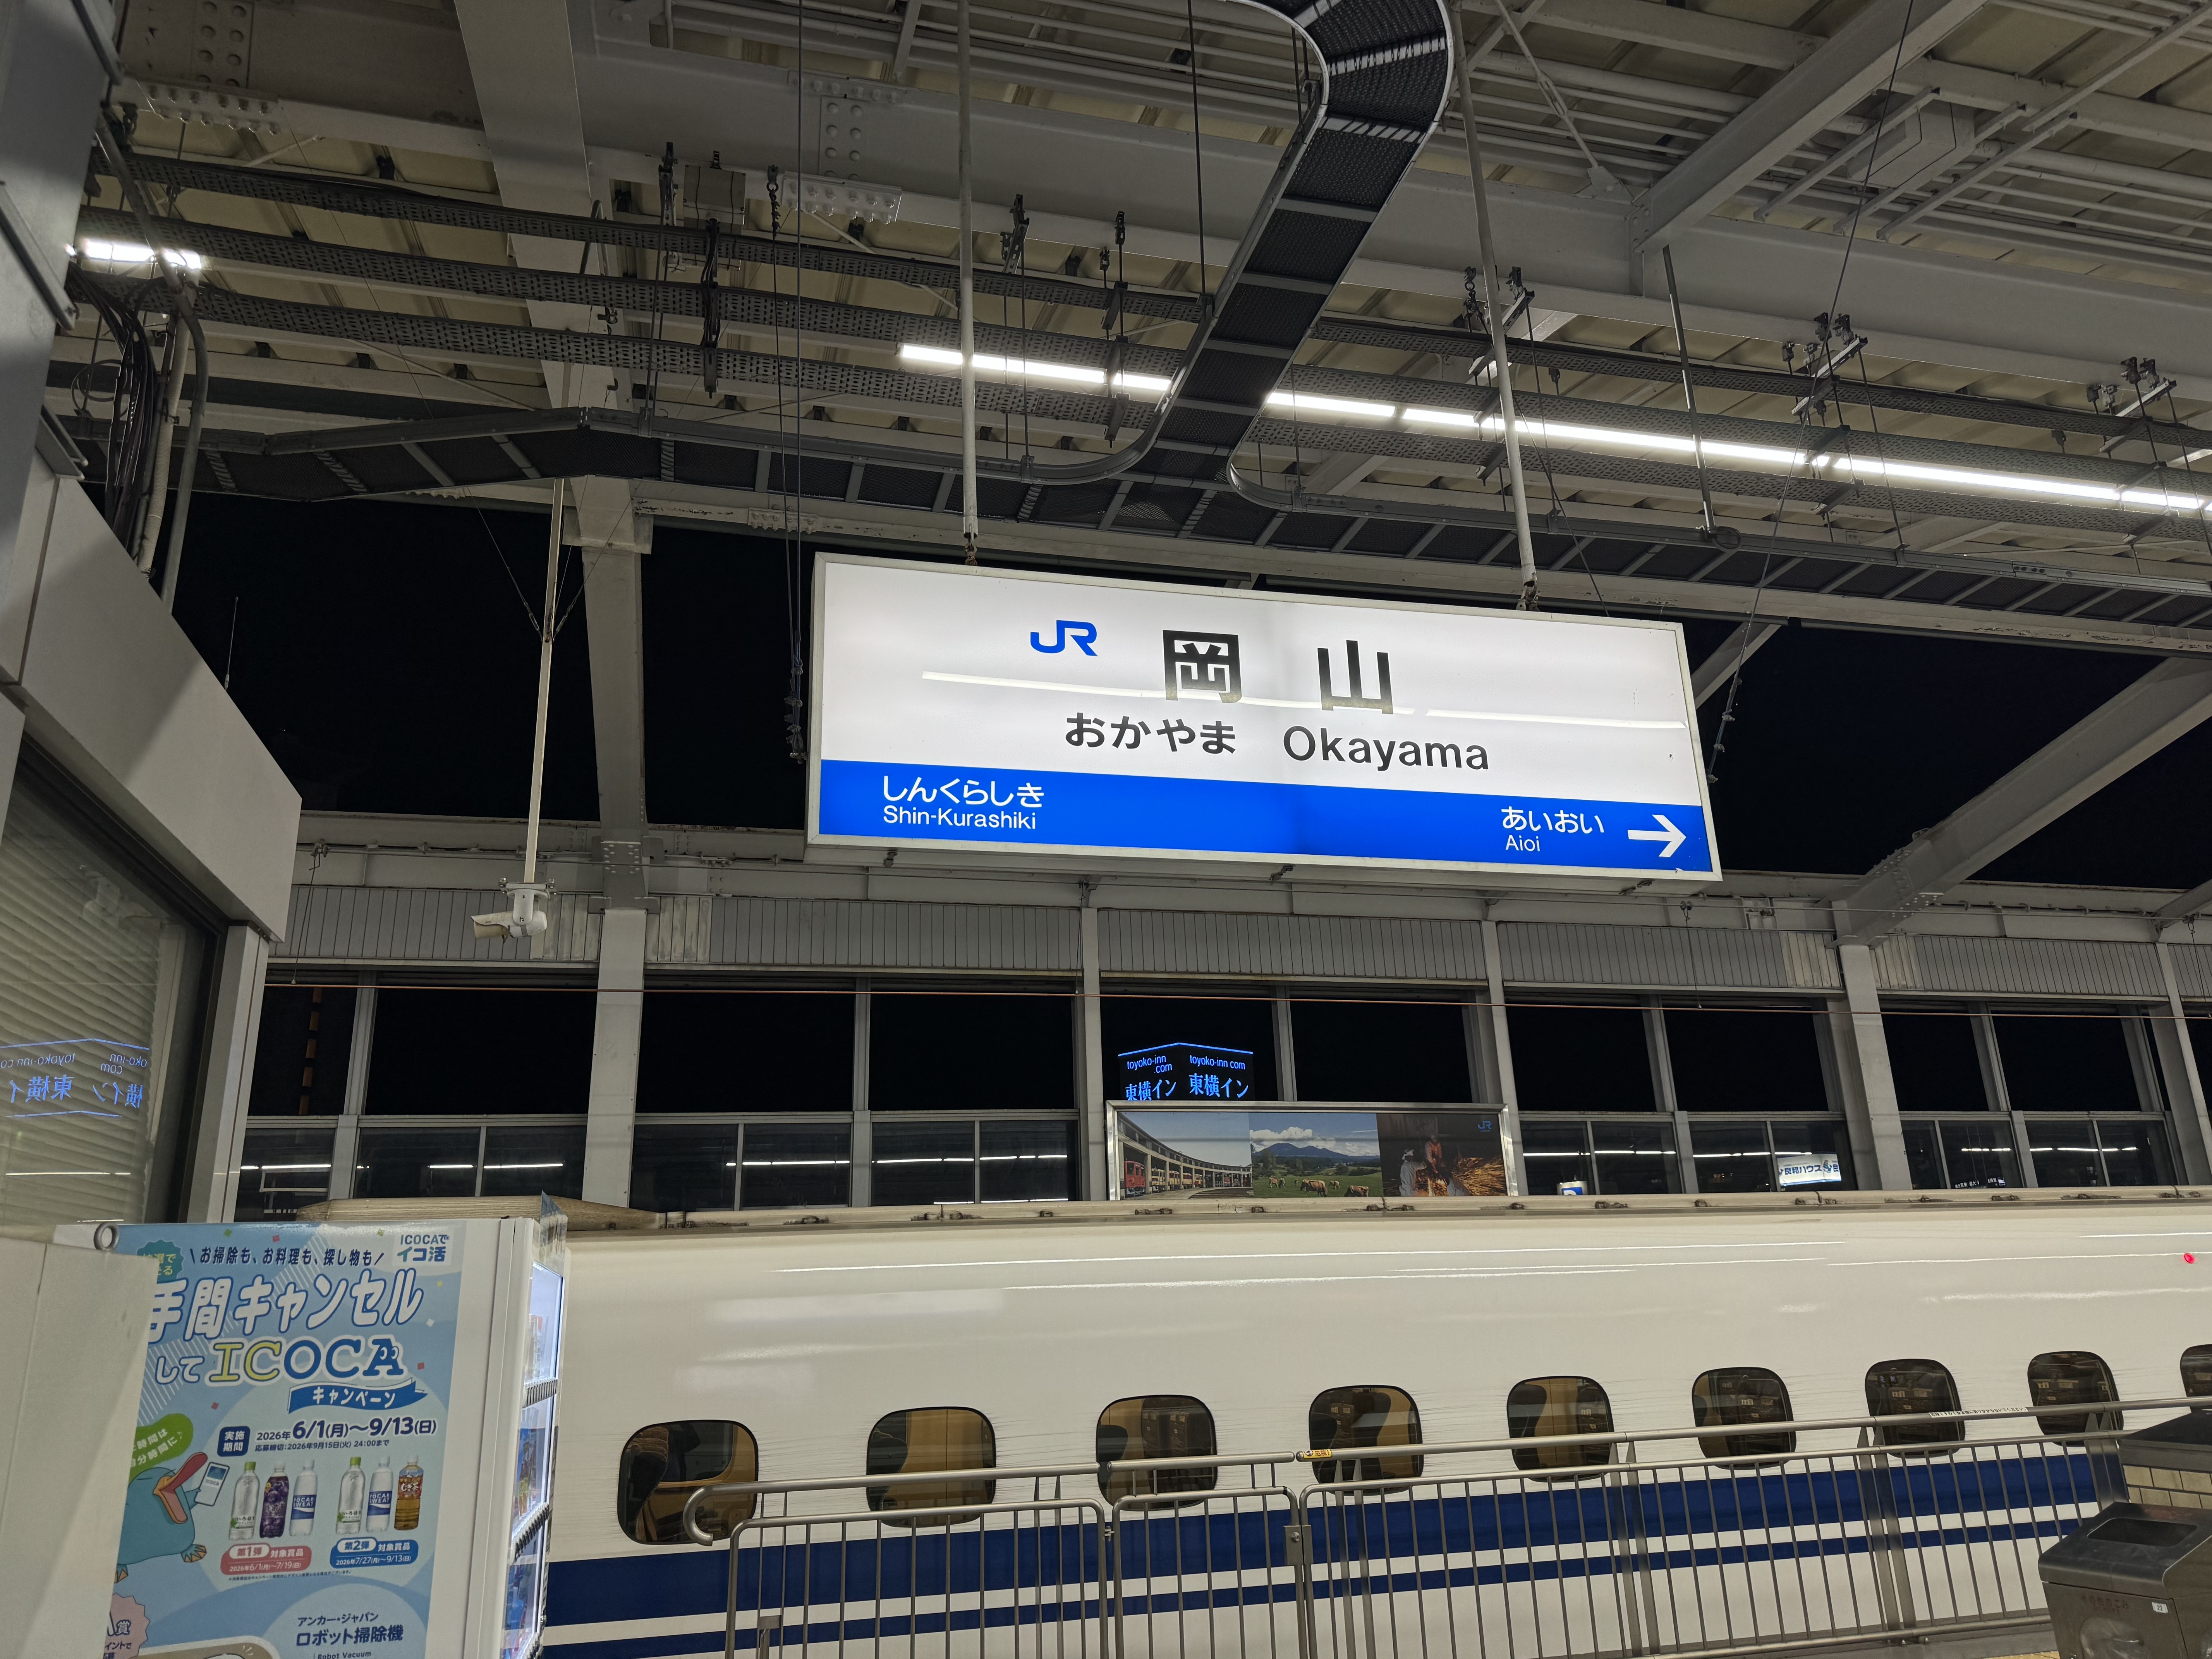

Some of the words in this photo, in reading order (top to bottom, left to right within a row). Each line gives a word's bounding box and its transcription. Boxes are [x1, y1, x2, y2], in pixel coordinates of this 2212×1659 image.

[1030, 620, 1097, 656] JR
[1066, 713, 1235, 754] おかやま
[1283, 726, 1488, 771] Okayama
[884, 775, 1044, 808] しんくらしき
[883, 805, 1036, 830] Shin-Kurashiki
[1501, 806, 1604, 834] あいおい
[1506, 835, 1540, 852] Aioi
[1127, 1055, 1166, 1070] toyoko-inn
[1190, 1055, 1245, 1070] toyoko-inn.com
[1125, 1079, 1176, 1101] 東横イン
[1188, 1073, 1249, 1099] 東横イン
[397, 1246, 446, 1262] イコ活
[313, 1386, 396, 1408] キャンペーン
[224, 1431, 245, 1441] 実施
[223, 1442, 243, 1452] 期間
[298, 1612, 378, 1626] アンカー・ジャパン
[296, 1625, 404, 1646] ロボット掃除機
